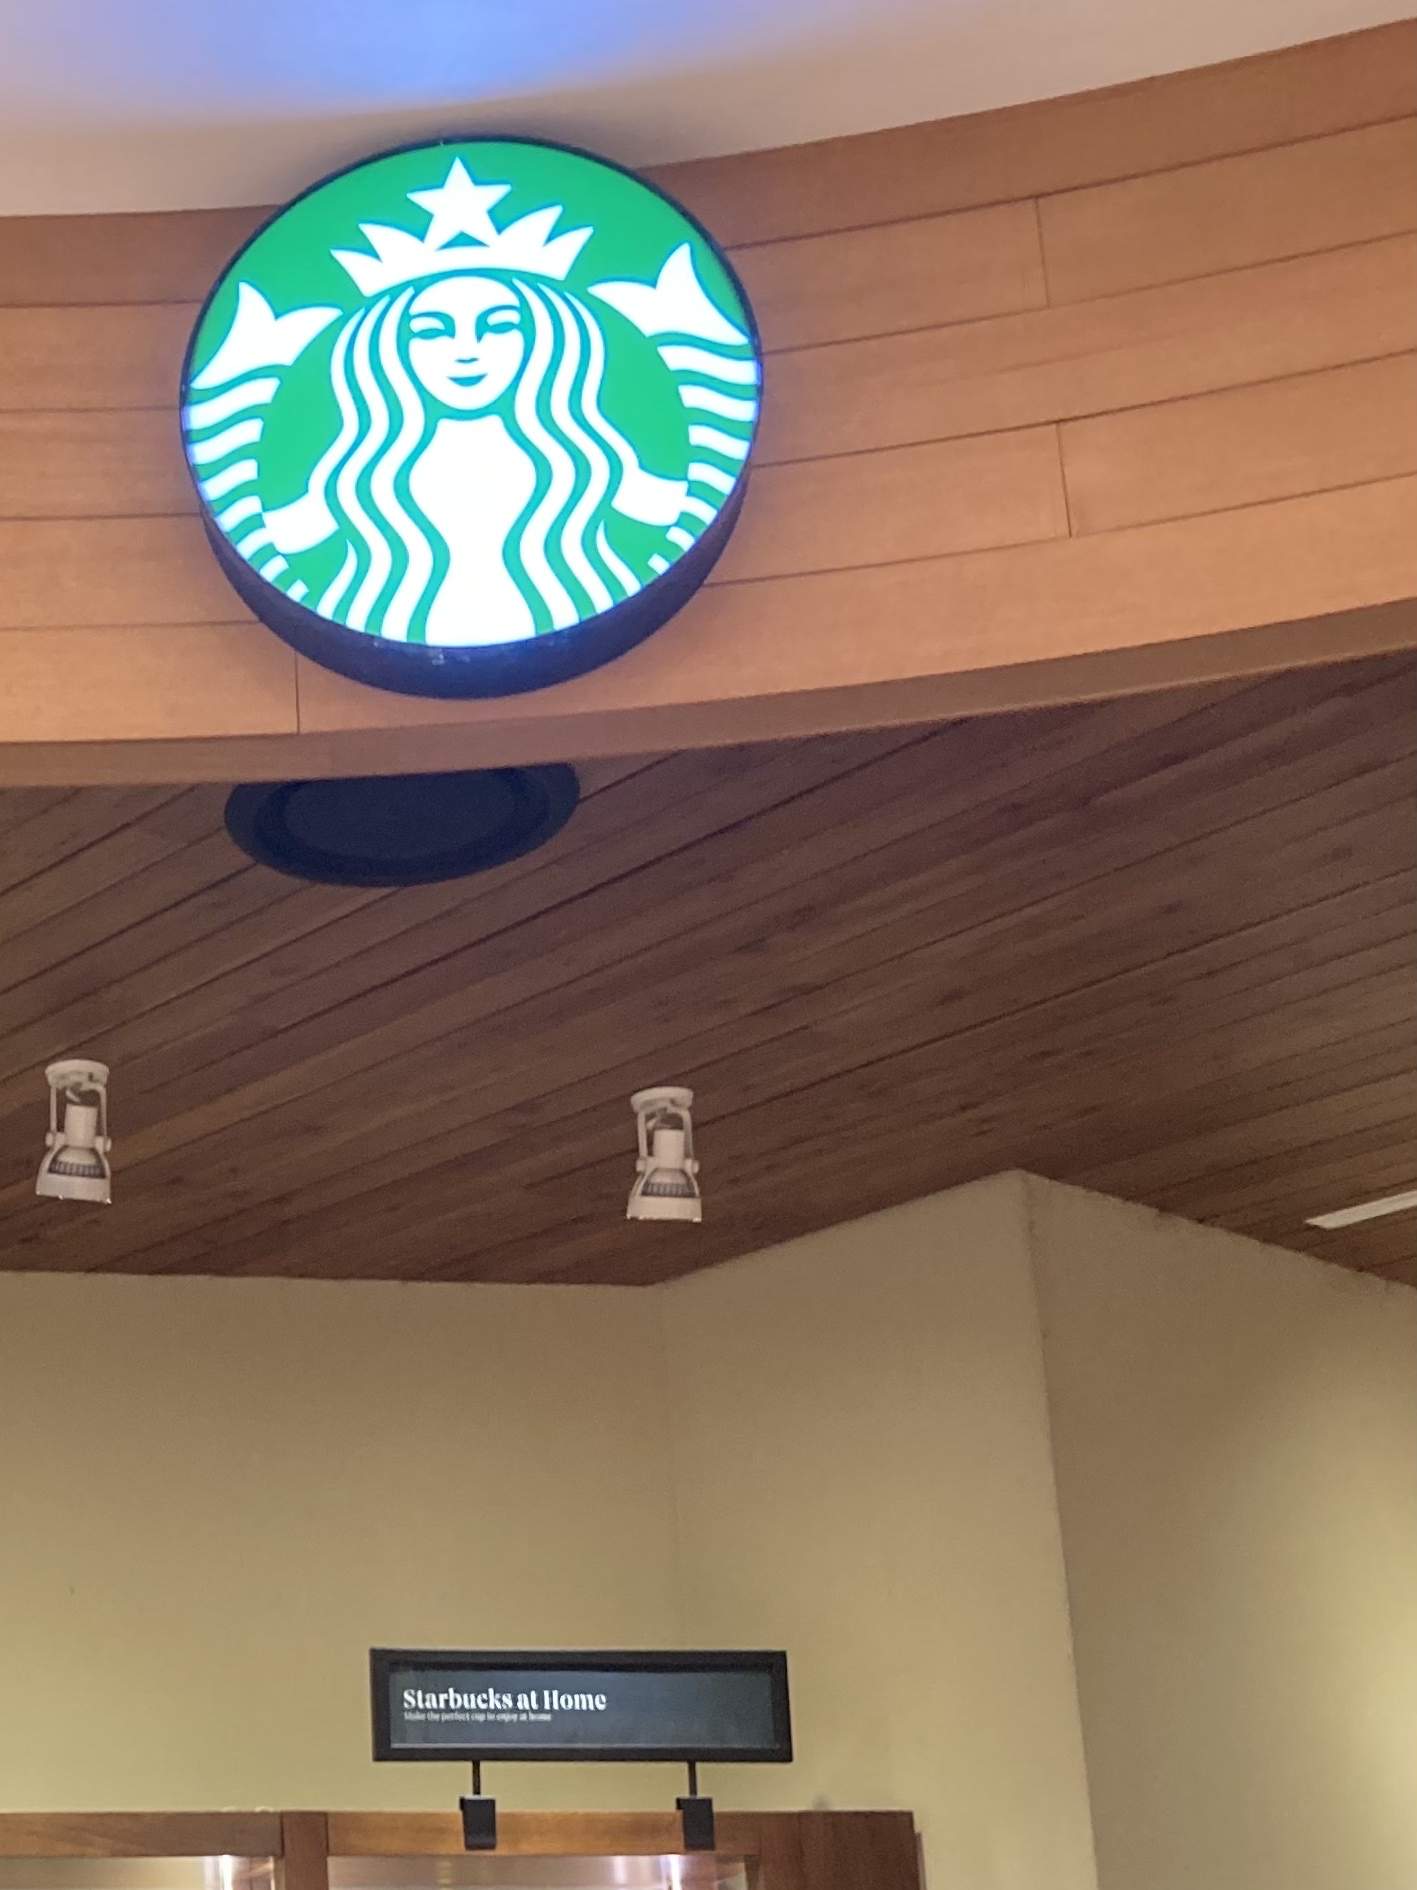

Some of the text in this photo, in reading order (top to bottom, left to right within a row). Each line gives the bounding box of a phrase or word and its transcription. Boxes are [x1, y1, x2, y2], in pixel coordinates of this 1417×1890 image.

[403, 1687, 608, 1711] Starbucks at Home
[427, 1712, 440, 1721] the
[441, 1711, 470, 1722] perfect
[471, 1713, 486, 1722] cup
[496, 1712, 518, 1722] enjoy
[519, 1712, 528, 1721] at
